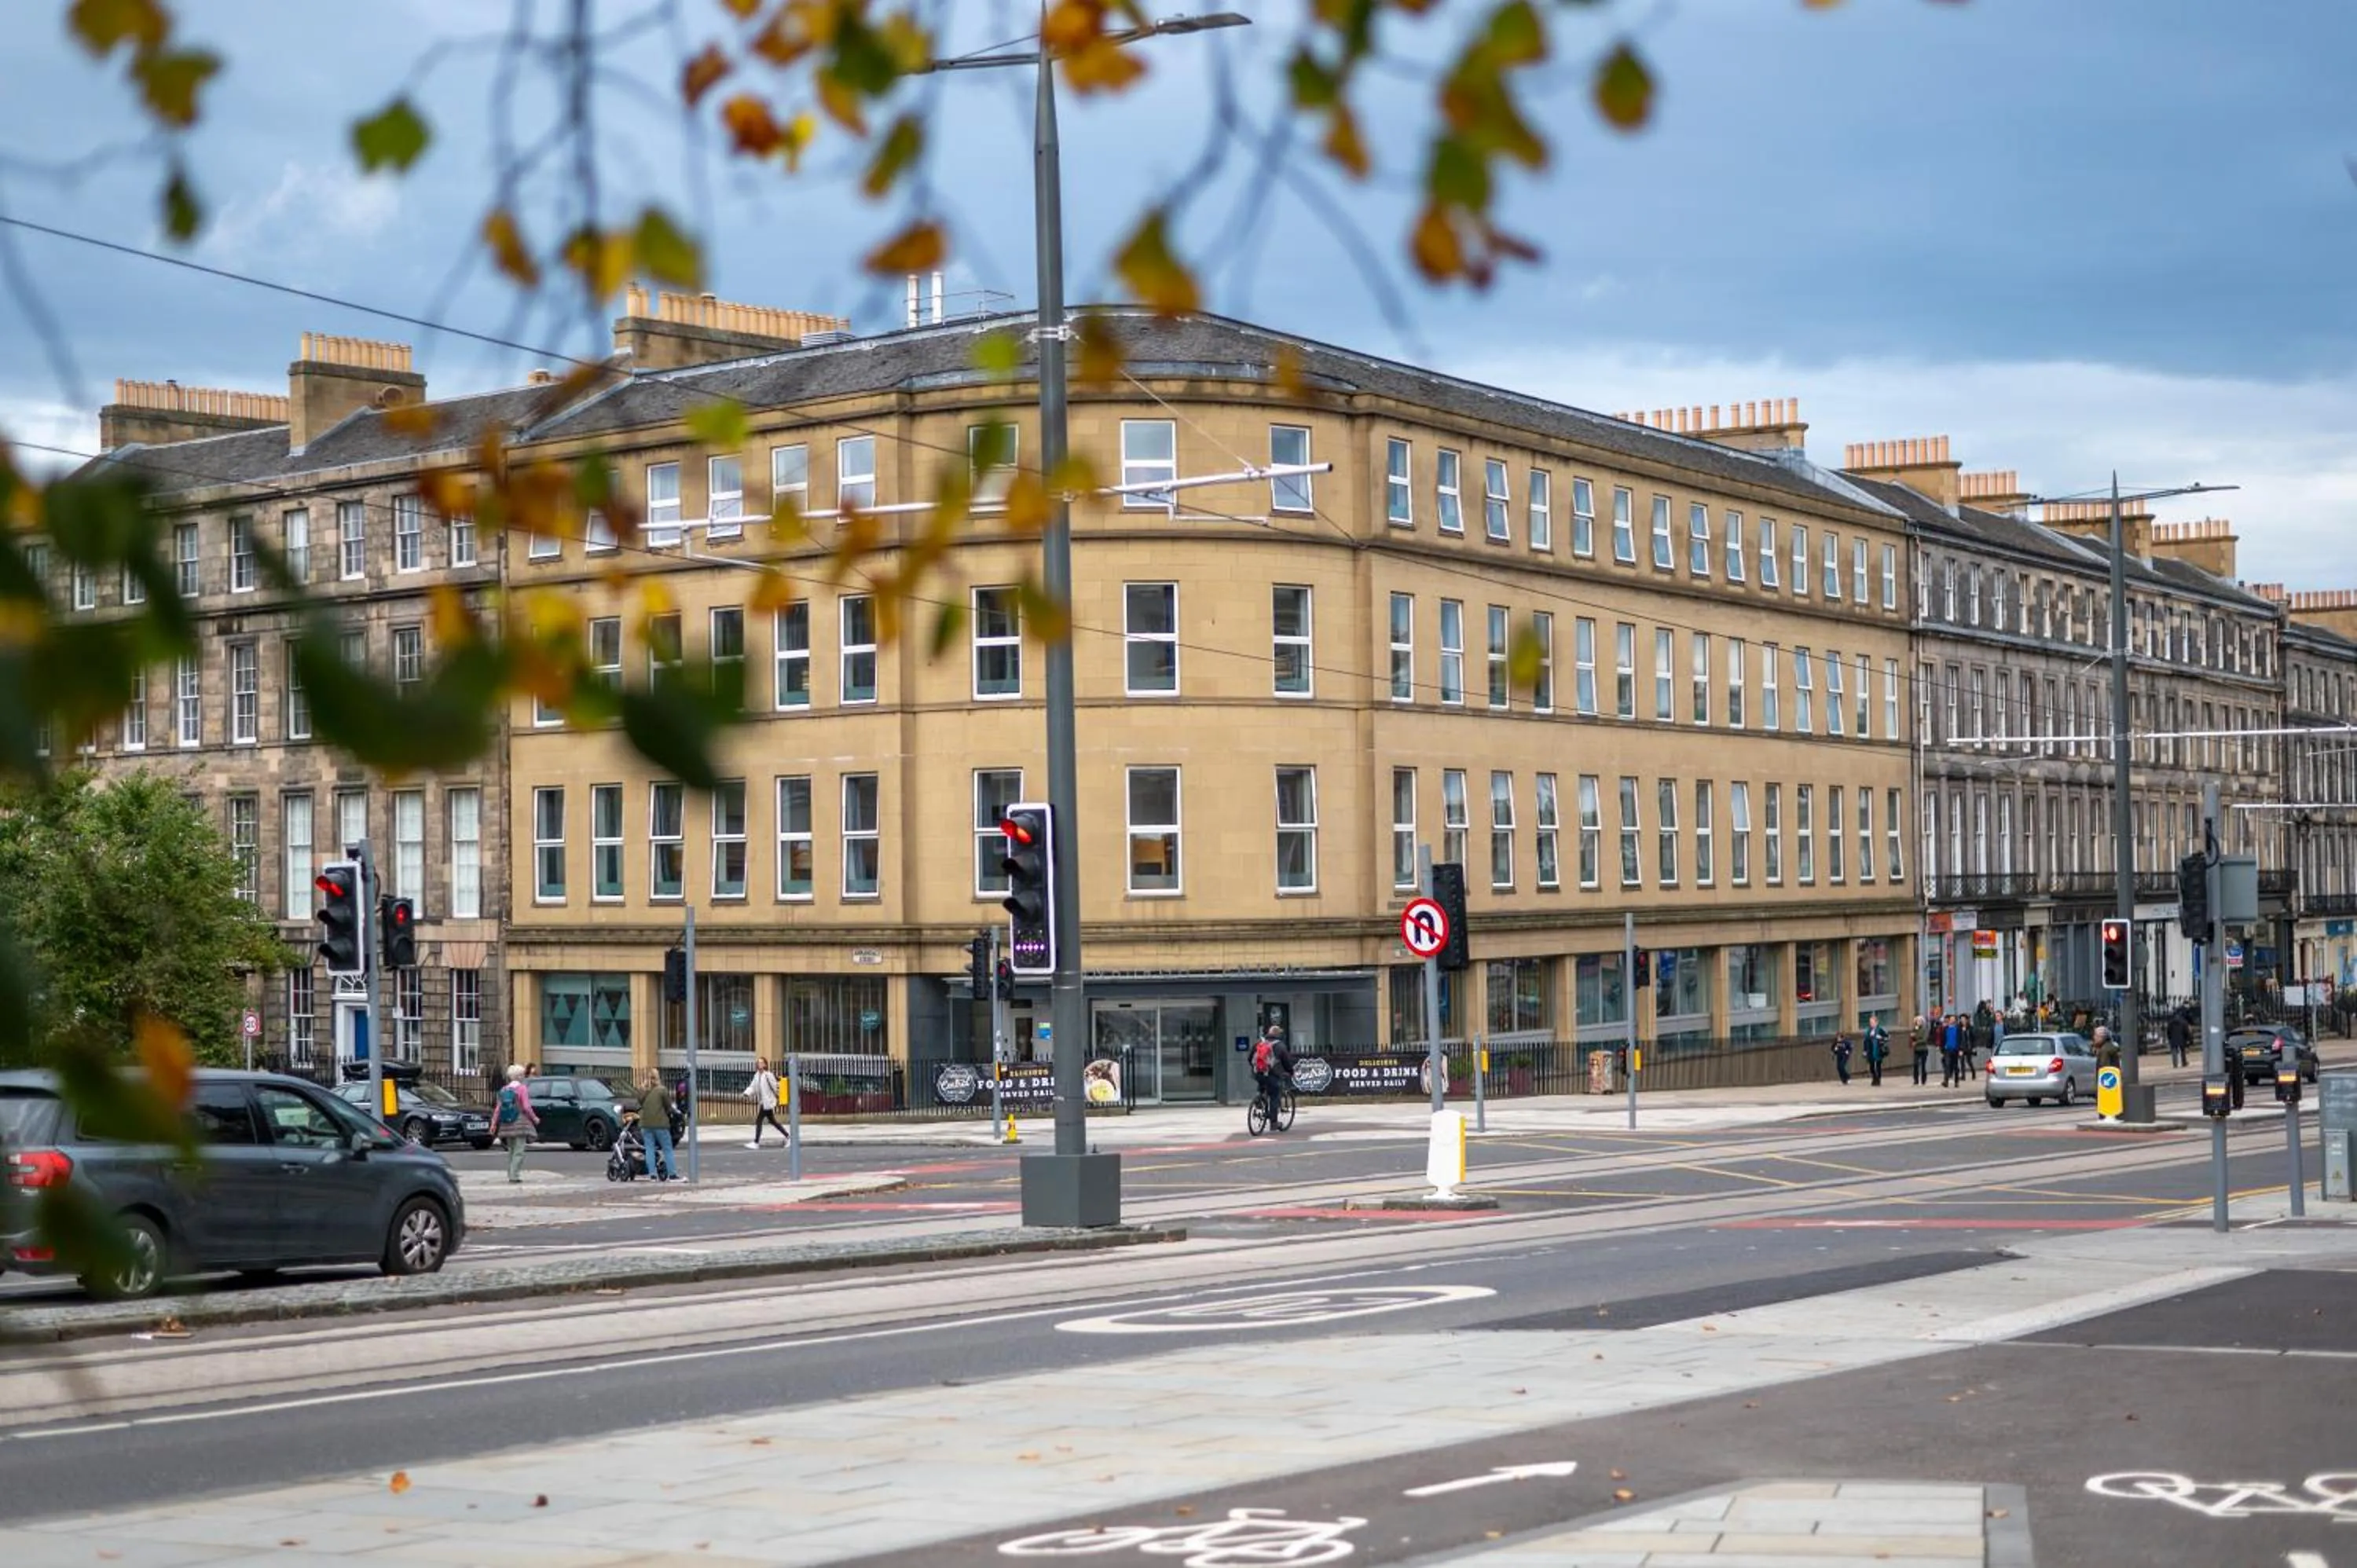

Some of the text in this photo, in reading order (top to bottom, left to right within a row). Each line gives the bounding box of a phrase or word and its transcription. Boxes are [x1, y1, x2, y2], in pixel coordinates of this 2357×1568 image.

[1009, 1068, 1049, 1077] ELICIOUS
[1335, 1068, 1368, 1079] FOOD
[1384, 1067, 1418, 1077] DRINK
[1019, 1079, 1026, 1088] &
[1032, 1077, 1054, 1088] DRI
